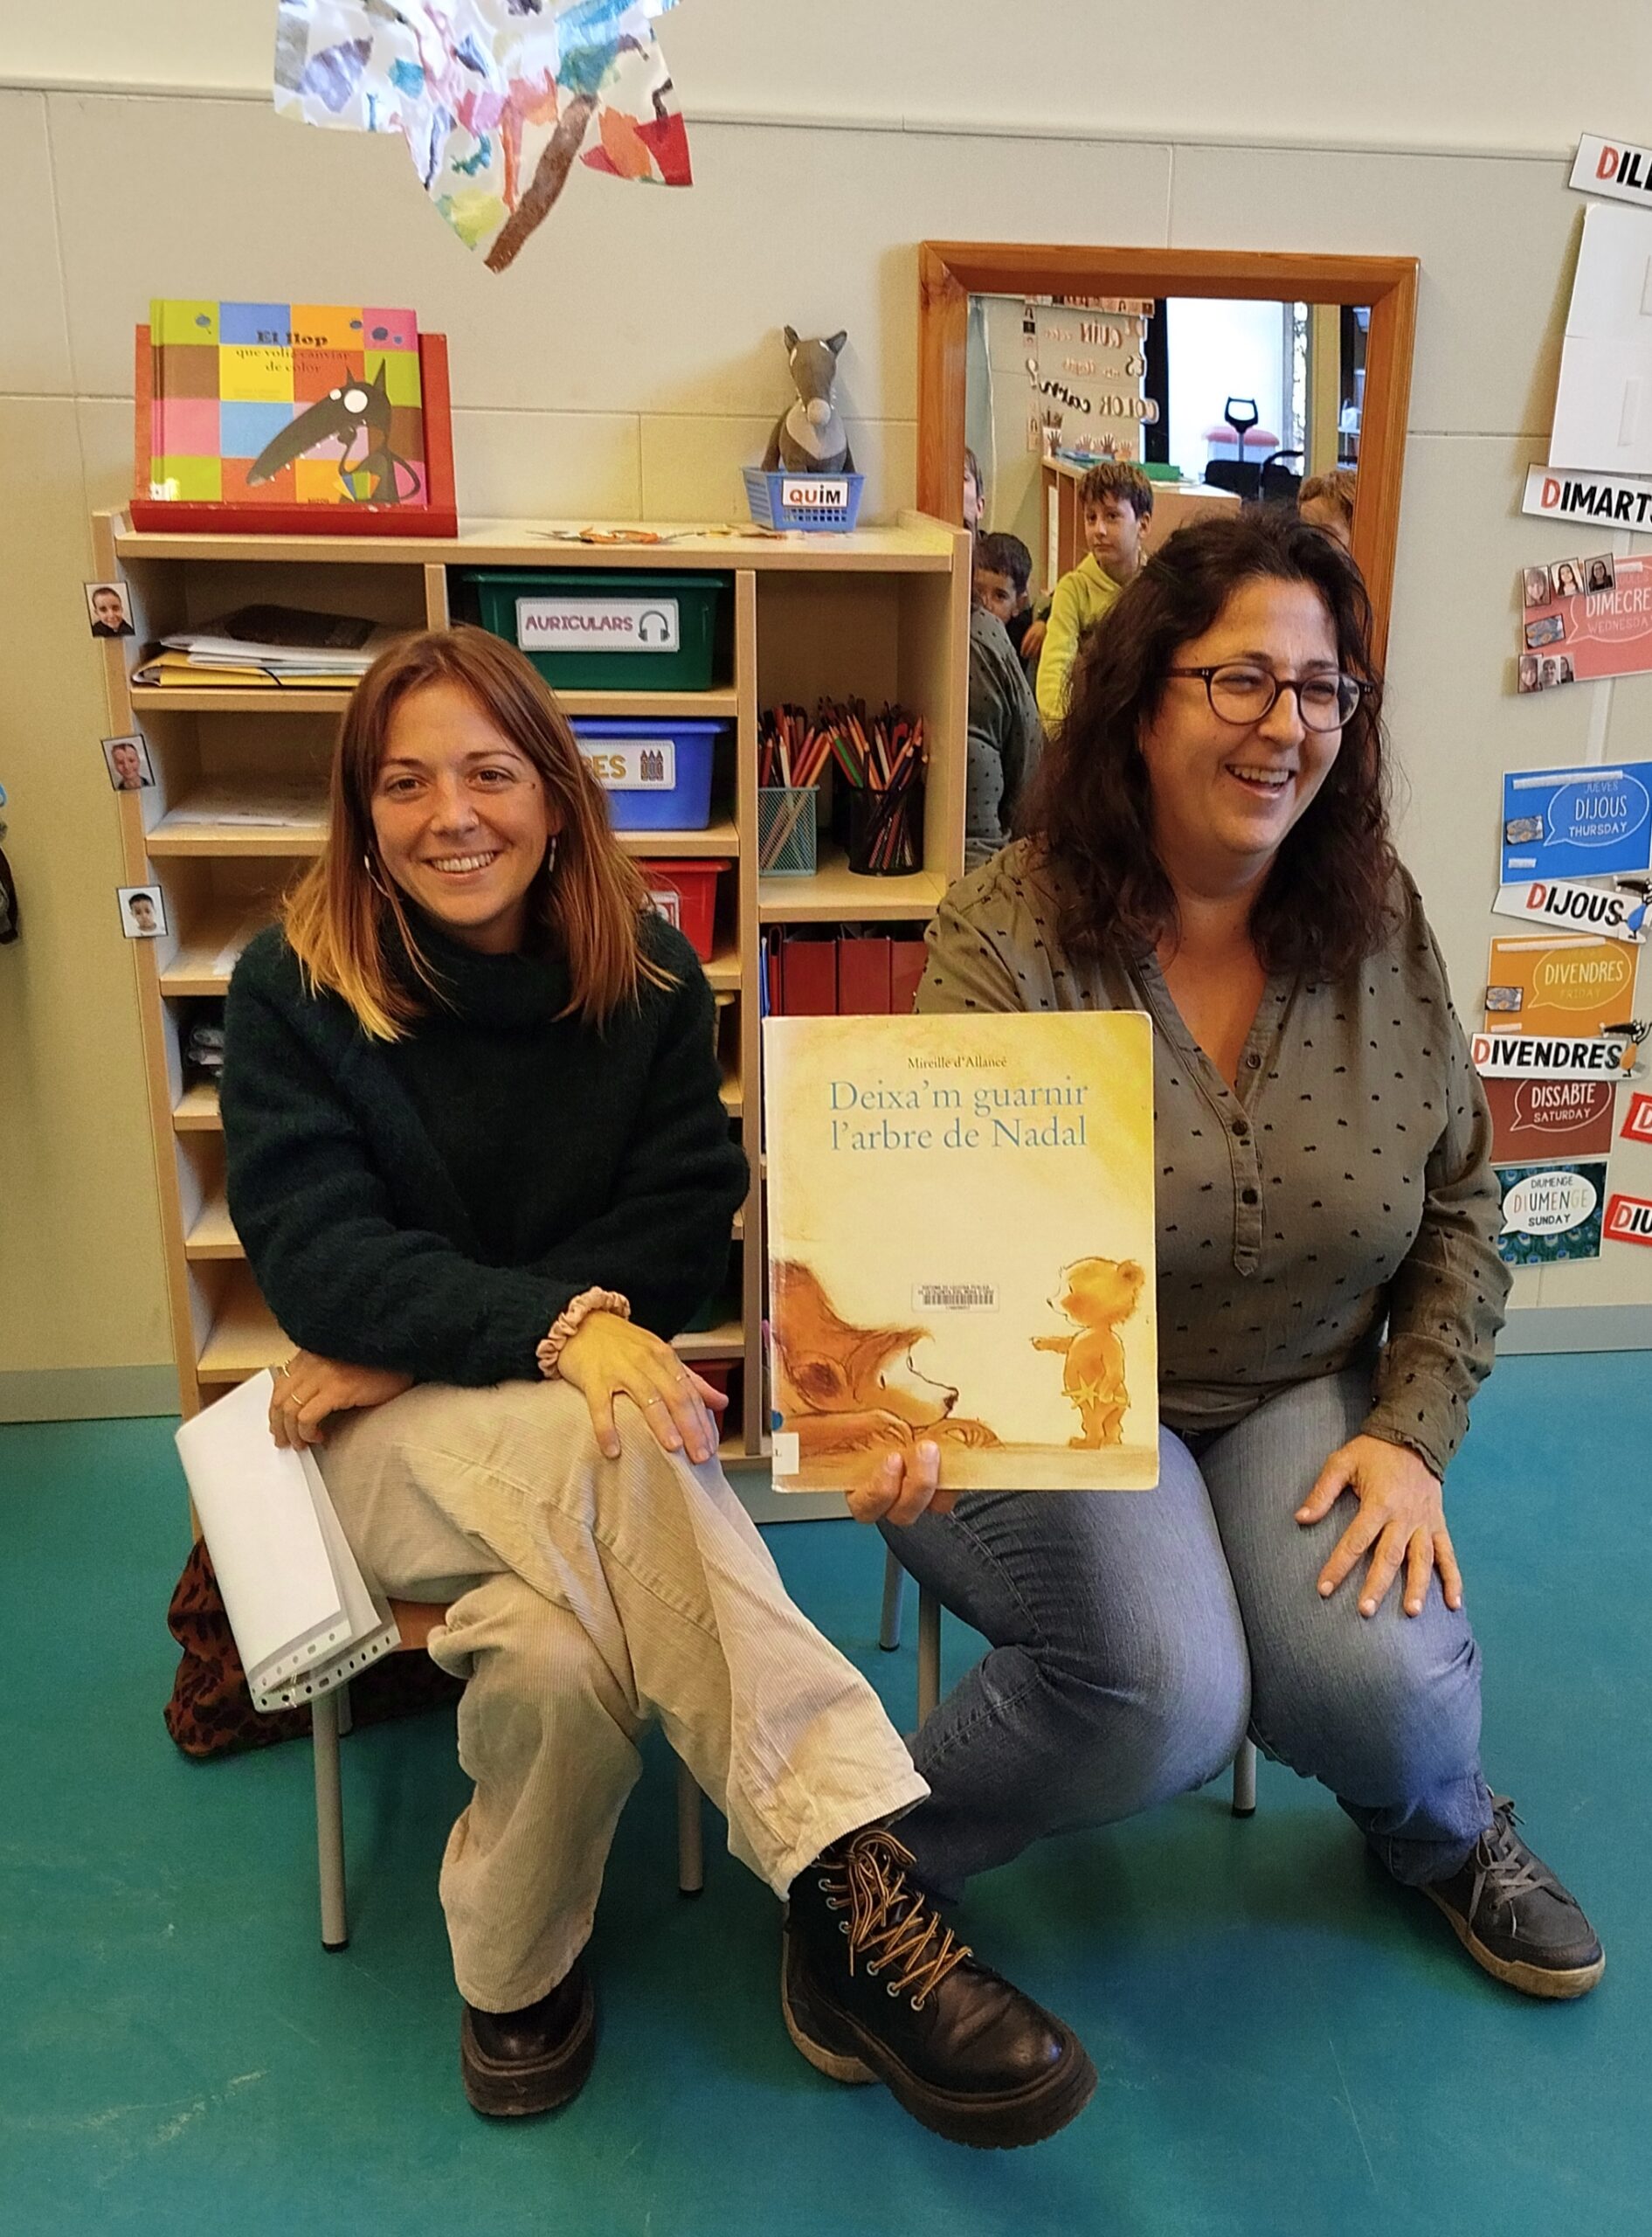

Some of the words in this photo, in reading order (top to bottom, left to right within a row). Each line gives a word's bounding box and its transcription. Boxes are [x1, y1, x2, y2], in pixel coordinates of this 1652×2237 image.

[257, 330, 278, 343] El
[286, 332, 328, 347] llop
[236, 350, 260, 359] que
[266, 361, 280, 371] de
[790, 484, 840, 504] QUIM
[1541, 477, 1652, 524] DIMART
[525, 615, 633, 631] AURICULARS
[1587, 615, 1652, 634] WEDNESDA
[1575, 795, 1627, 821] DIJOUS
[1569, 821, 1628, 837] THURSDAY
[1526, 883, 1624, 926] DIJOUS
[1545, 960, 1623, 985] DIVENDRES
[1559, 987, 1601, 1000] FRIDAY
[908, 1056, 950, 1069] Mireille
[954, 1056, 1007, 1068] d'Allancé
[1474, 1038, 1622, 1070] DIVENDRES
[830, 1079, 962, 1111] Deixa'm
[974, 1075, 1089, 1118] guarnir
[1531, 1083, 1597, 1108] DISSABTE
[1534, 1108, 1591, 1124] SATURDAY
[832, 1118, 933, 1151] l'arbre
[944, 1117, 980, 1148] de
[992, 1114, 1089, 1147] Nadal
[1531, 1176, 1573, 1189] DIUMENGE
[1514, 1188, 1589, 1214] DIUMENGE
[1528, 1214, 1572, 1227] SUNDAY
